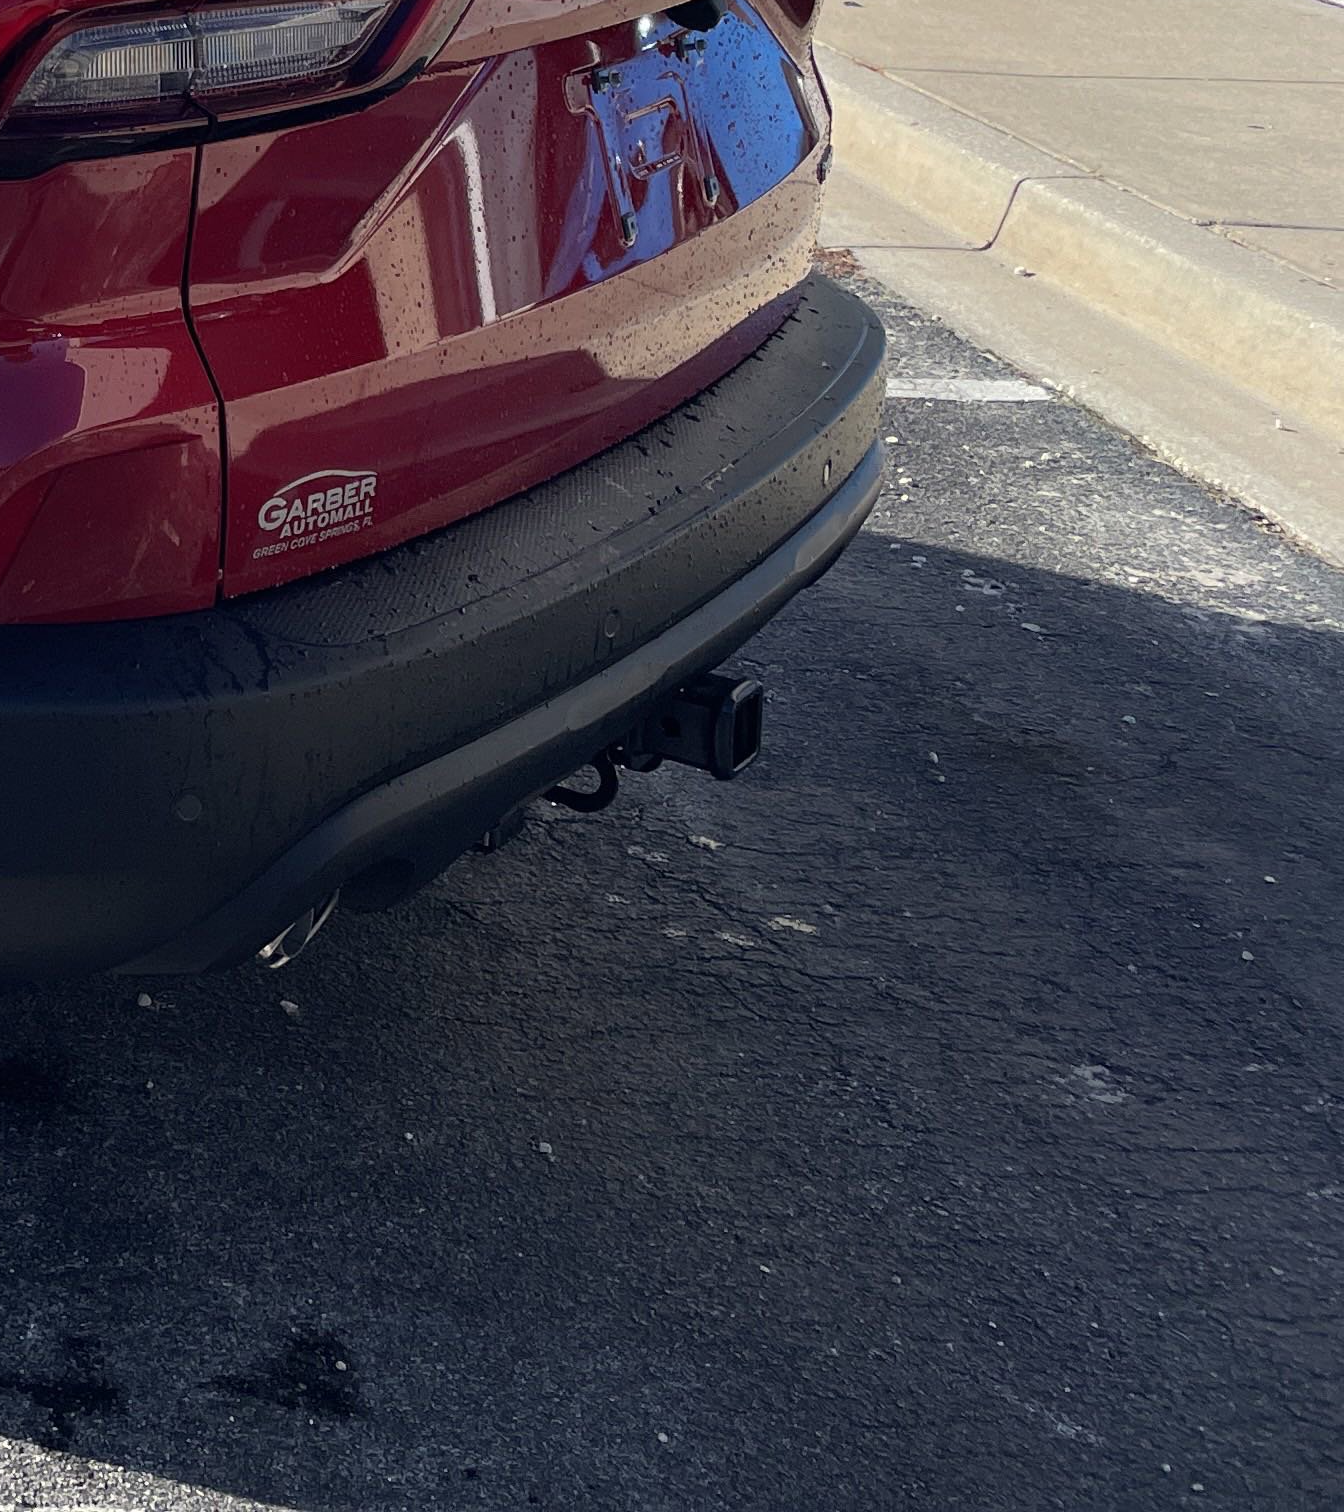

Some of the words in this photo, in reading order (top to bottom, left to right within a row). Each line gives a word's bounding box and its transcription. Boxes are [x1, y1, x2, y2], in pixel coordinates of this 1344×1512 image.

[258, 476, 377, 531] GARBER
[279, 498, 374, 539] AUTOMALL
[252, 541, 290, 560] GREEN
[289, 533, 319, 550] COVE
